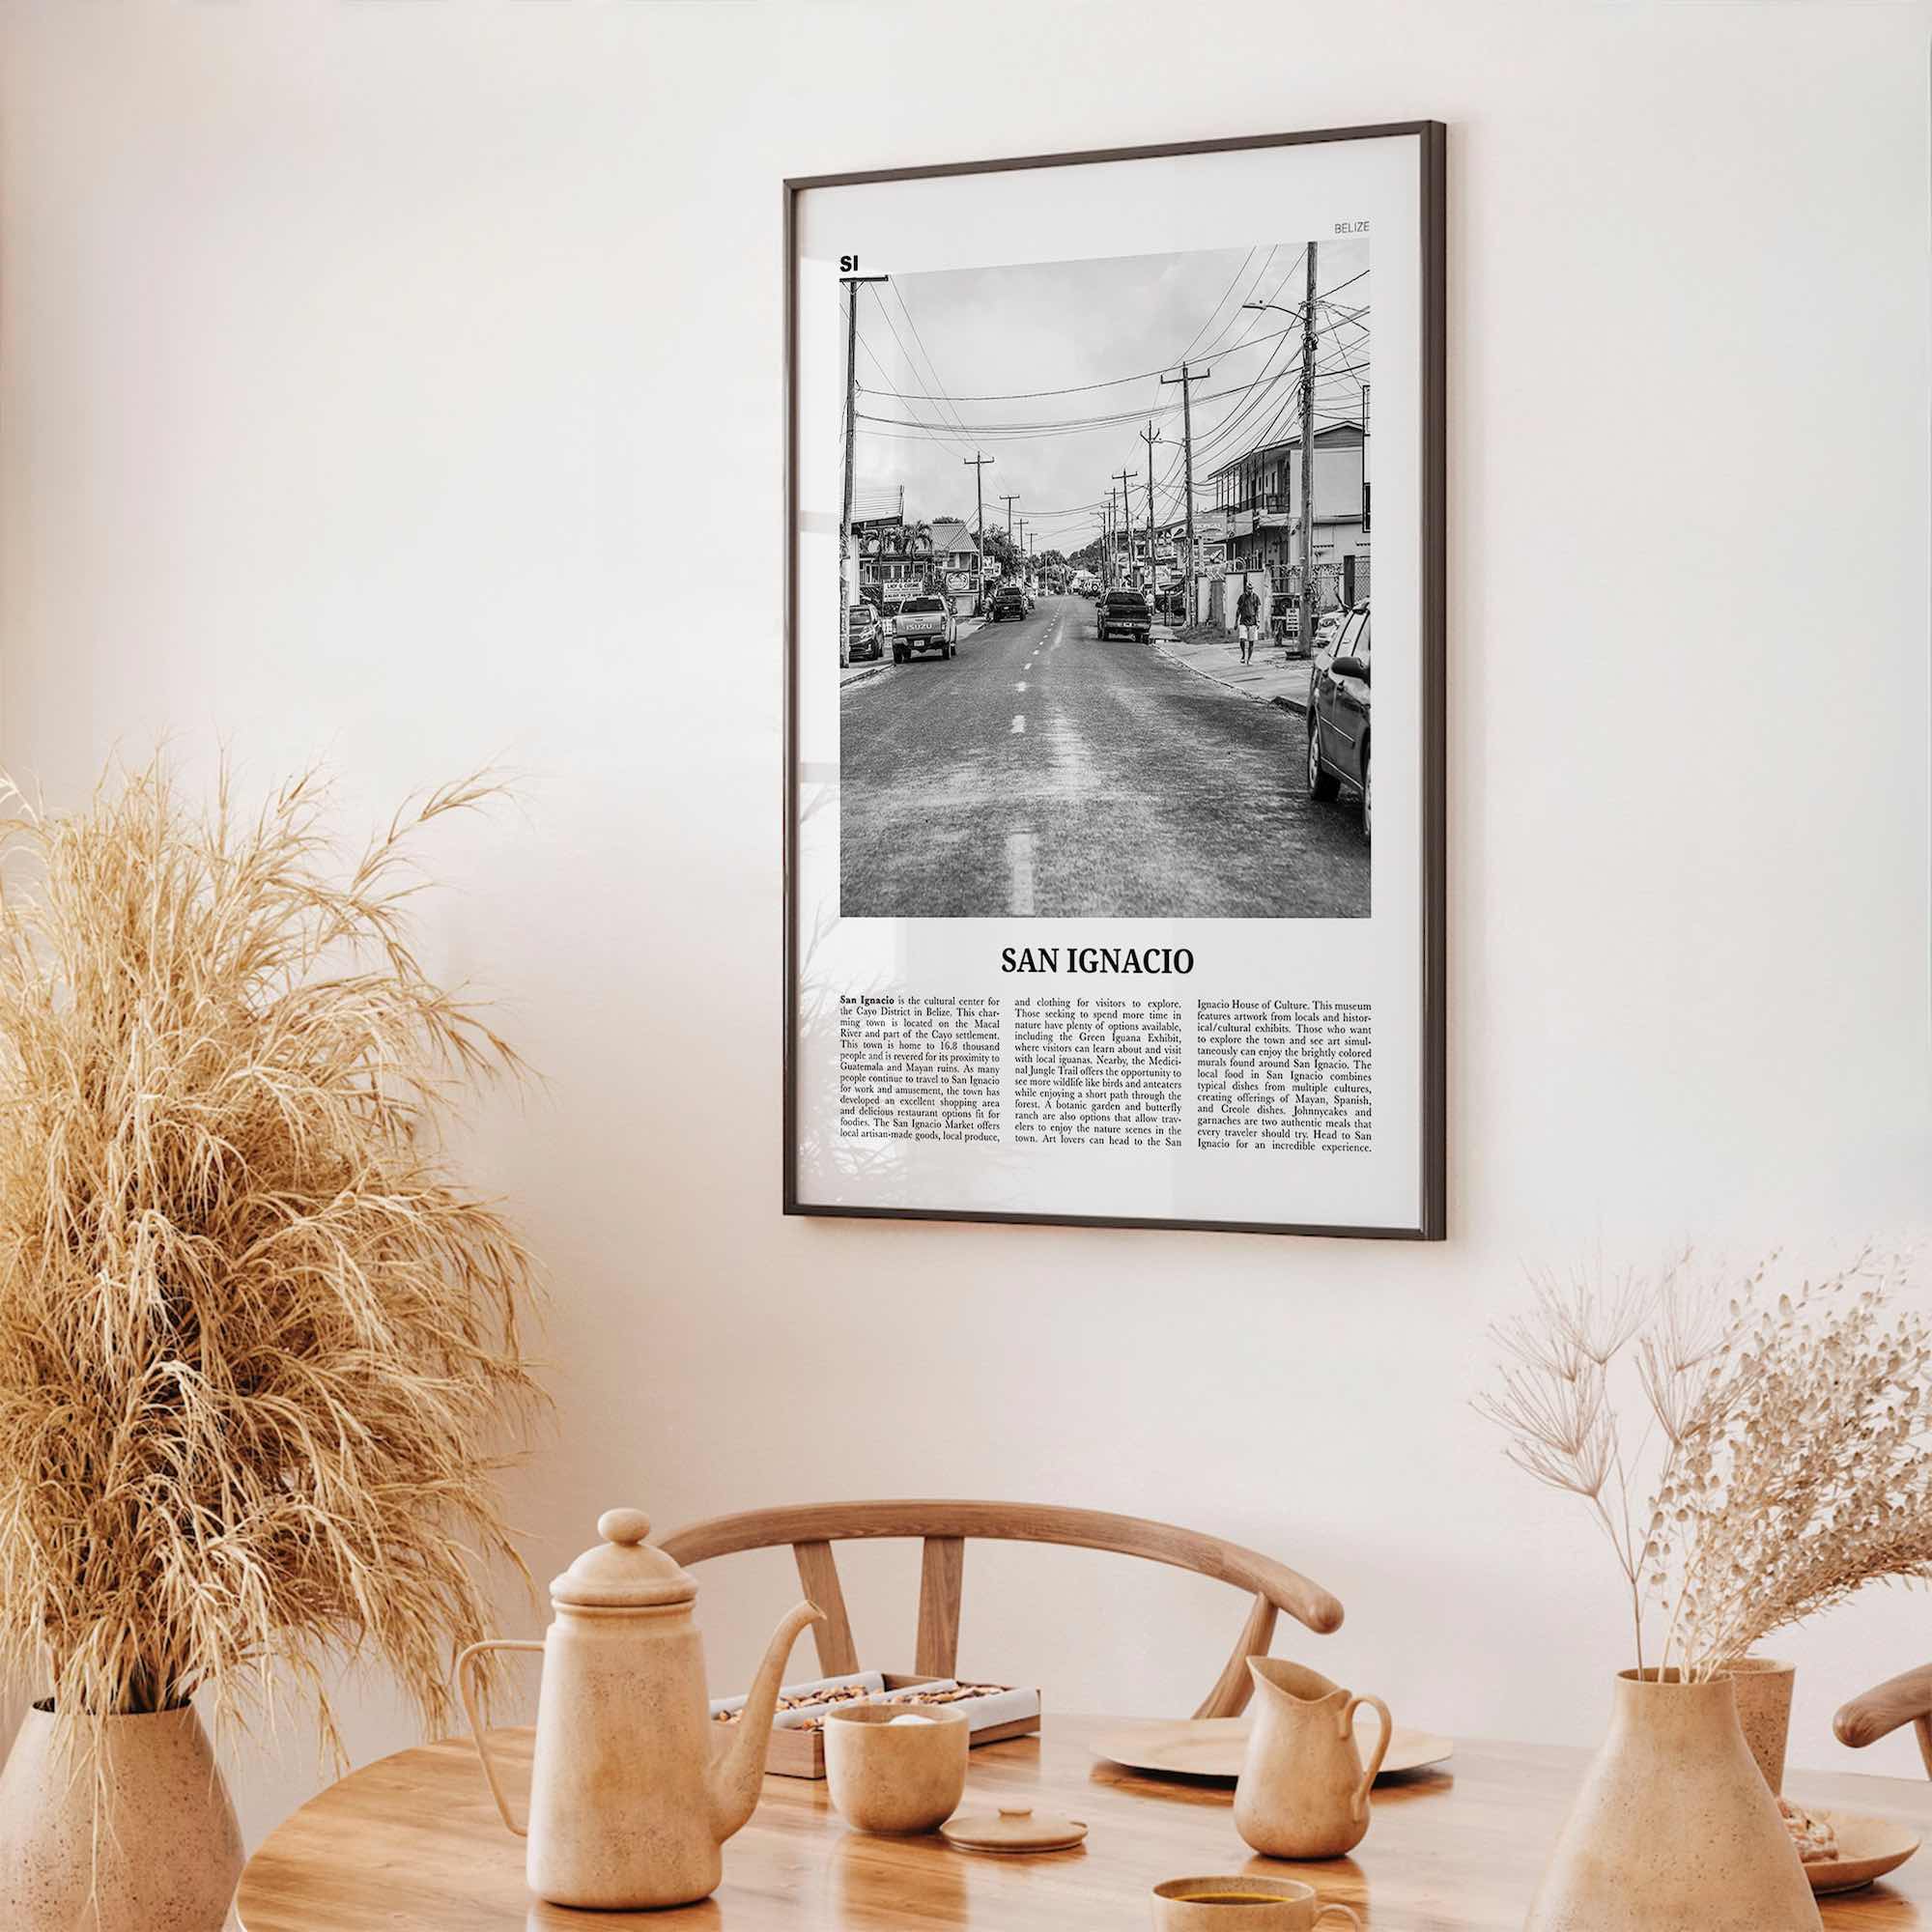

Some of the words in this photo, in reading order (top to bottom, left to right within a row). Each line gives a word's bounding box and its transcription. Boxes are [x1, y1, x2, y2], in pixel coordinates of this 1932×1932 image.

[1334, 220, 1370, 234] BELIZE
[839, 254, 859, 271] SI
[1001, 947, 1060, 974] SAN
[1066, 947, 1194, 975] IGNACIO
[861, 996, 895, 1008] Ignacio
[1037, 998, 1070, 1009] clothing
[1095, 999, 1125, 1008] visitors
[1198, 1001, 1229, 1011] Ignacio
[1232, 1001, 1259, 1009] House
[1311, 1002, 1332, 1010] This
[881, 1008, 910, 1016] District
[1044, 1009, 1075, 1021] seeking
[1093, 1010, 1117, 1021] spend
[1234, 1012, 1266, 1021] artwork
[1294, 1013, 1320, 1022] locals
[839, 1018, 860, 1029] ming
[1066, 1021, 1092, 1033] plenty
[1107, 1022, 1139, 1034] options
[1197, 1024, 1250, 1033] ical/cultural
[1296, 1025, 1322, 1034] Those
[883, 1030, 899, 1040] part
[1014, 1032, 1053, 1043] including
[1079, 1033, 1104, 1041] Green
[1112, 1034, 1141, 1044] Iguana
[1209, 1036, 1241, 1046] explore
[1344, 1037, 1371, 1046] simul-
[840, 1040, 858, 1049] This
[898, 1041, 921, 1050] home
[962, 1042, 999, 1051] thousand
[1014, 1043, 1038, 1052] where
[1118, 1045, 1141, 1054] about
[839, 1052, 866, 1063] people
[894, 1052, 923, 1061] revered
[950, 1053, 989, 1065] proximity
[1197, 1047, 1237, 1058] taneously
[1258, 1048, 1282, 1059] enjoy
[1301, 1048, 1335, 1060] brightly
[1338, 1049, 1371, 1058] colored
[1014, 1055, 1033, 1064] with
[1036, 1055, 1055, 1064] local
[1149, 1057, 1180, 1065] Medici-
[1197, 1059, 1226, 1067] murals
[1230, 1059, 1254, 1067] found
[1258, 1060, 1290, 1068] around
[839, 1063, 883, 1071] Guatemala
[906, 1064, 933, 1075] Mayan
[978, 1066, 999, 1076] many
[1028, 1066, 1055, 1077] Jungle
[1080, 1067, 1103, 1076] offers
[1121, 1068, 1171, 1080] opportunity
[839, 1074, 866, 1085] people
[868, 1074, 902, 1083] continue
[916, 1075, 938, 1084] travel
[970, 1076, 1000, 1087] Ignacio
[1197, 1070, 1217, 1079] local
[1224, 1070, 1243, 1079] food
[1291, 1072, 1322, 1083] Ignacio
[1329, 1072, 1372, 1081] combines
[854, 1085, 873, 1094] work
[1052, 1078, 1083, 1087] wildlife
[1085, 1079, 1099, 1088] like
[1102, 1079, 1122, 1088] birds
[1143, 1080, 1181, 1089] anteaters
[1197, 1082, 1226, 1093] typical
[1292, 1084, 1327, 1094] multiple
[1014, 1089, 1037, 1097] while
[1039, 1090, 1074, 1100] enjoying
[1085, 1091, 1106, 1099] short
[1131, 1092, 1164, 1102] through
[1197, 1094, 1232, 1105] creating
[1236, 1094, 1274, 1105] offerings
[839, 1095, 879, 1107] developed
[899, 1097, 934, 1106] excellent
[940, 1098, 977, 1109] shopping
[1056, 1101, 1086, 1110] botanic
[1091, 1102, 1120, 1113] garden
[1145, 1103, 1181, 1115] butterfly
[858, 1107, 894, 1117] delicious
[897, 1108, 937, 1118] restaurant
[941, 1109, 971, 1121] options
[1014, 1112, 1037, 1121] ranch
[1059, 1113, 1075, 1122] also
[1079, 1113, 1110, 1124] options
[1114, 1114, 1130, 1122] that
[1292, 1107, 1347, 1119] Johnnycakes
[912, 1120, 941, 1131] Ignacio
[945, 1121, 974, 1129] Market
[977, 1122, 1000, 1130] offers
[1197, 1117, 1240, 1128] garnaches
[1281, 1119, 1321, 1127] authentic
[1325, 1120, 1350, 1128] meals
[1354, 1120, 1372, 1128] that
[839, 1129, 858, 1138] local
[861, 1129, 912, 1139] artisan-made
[943, 1132, 961, 1141] local
[1050, 1124, 1072, 1135] enjoy
[1197, 1130, 1220, 1140] every
[1224, 1129, 1257, 1138] traveler
[1261, 1130, 1290, 1139] should
[1313, 1131, 1337, 1140] Head
[1198, 1140, 1230, 1151] Ignacio
[1272, 1142, 1315, 1151] incredible
